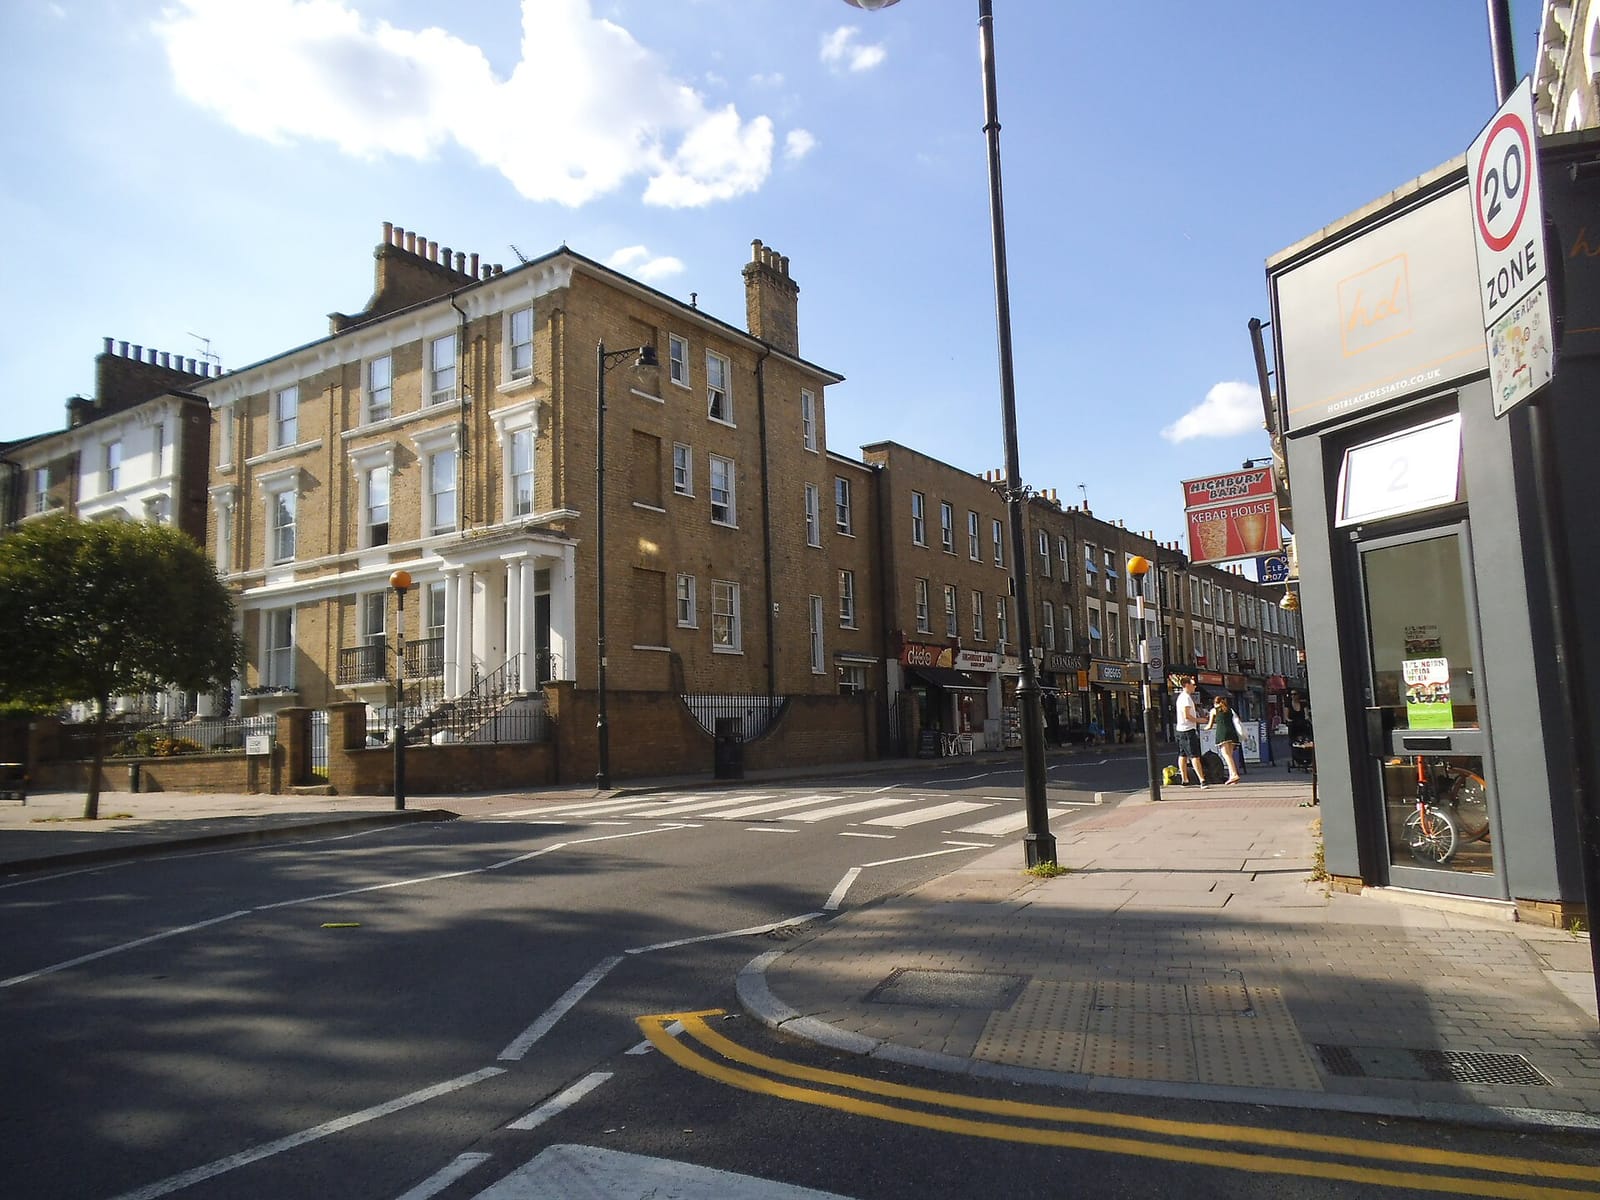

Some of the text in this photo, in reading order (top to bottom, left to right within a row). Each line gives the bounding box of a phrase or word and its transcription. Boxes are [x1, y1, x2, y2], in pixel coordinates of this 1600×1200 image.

[1484, 144, 1521, 223] 20
[1487, 239, 1536, 310] ZONE
[1328, 369, 1441, 412] HOTBLACKDESIATO.CO.UK
[1190, 473, 1265, 493] HIGHBURY
[1386, 455, 1409, 492] 2
[1210, 486, 1248, 499] BARN
[1191, 510, 1228, 523] KEBAB
[1231, 504, 1271, 518] HOUSE
[908, 646, 932, 666] dido
